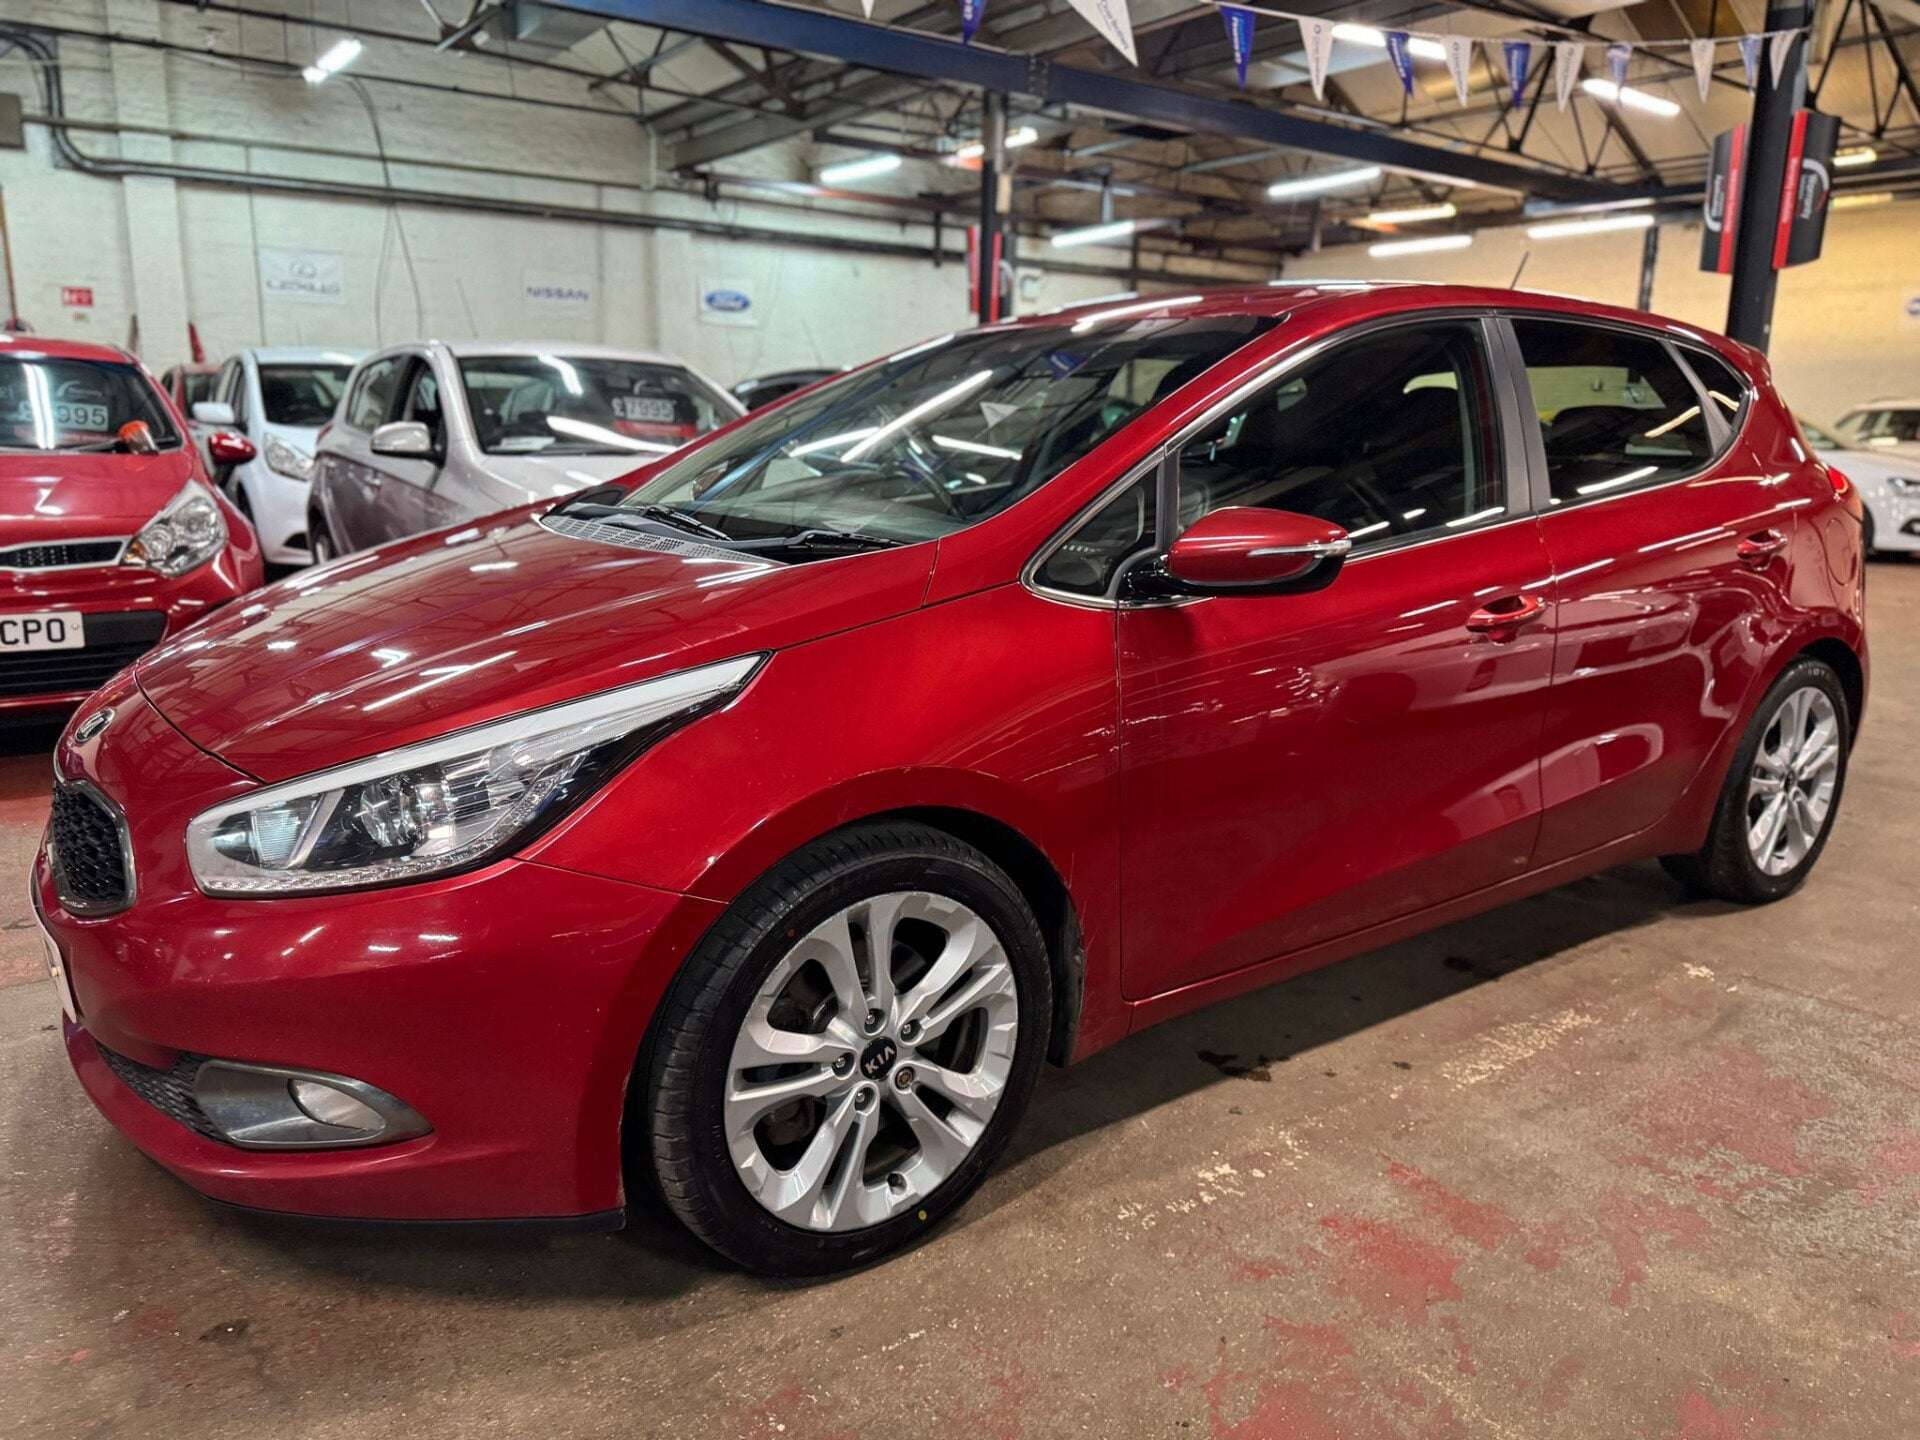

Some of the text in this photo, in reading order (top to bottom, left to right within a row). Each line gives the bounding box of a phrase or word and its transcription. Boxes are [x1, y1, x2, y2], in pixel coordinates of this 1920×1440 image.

[526, 286, 590, 302] NISSAN
[0, 618, 66, 645] CPO
[864, 1046, 895, 1074] KIA
